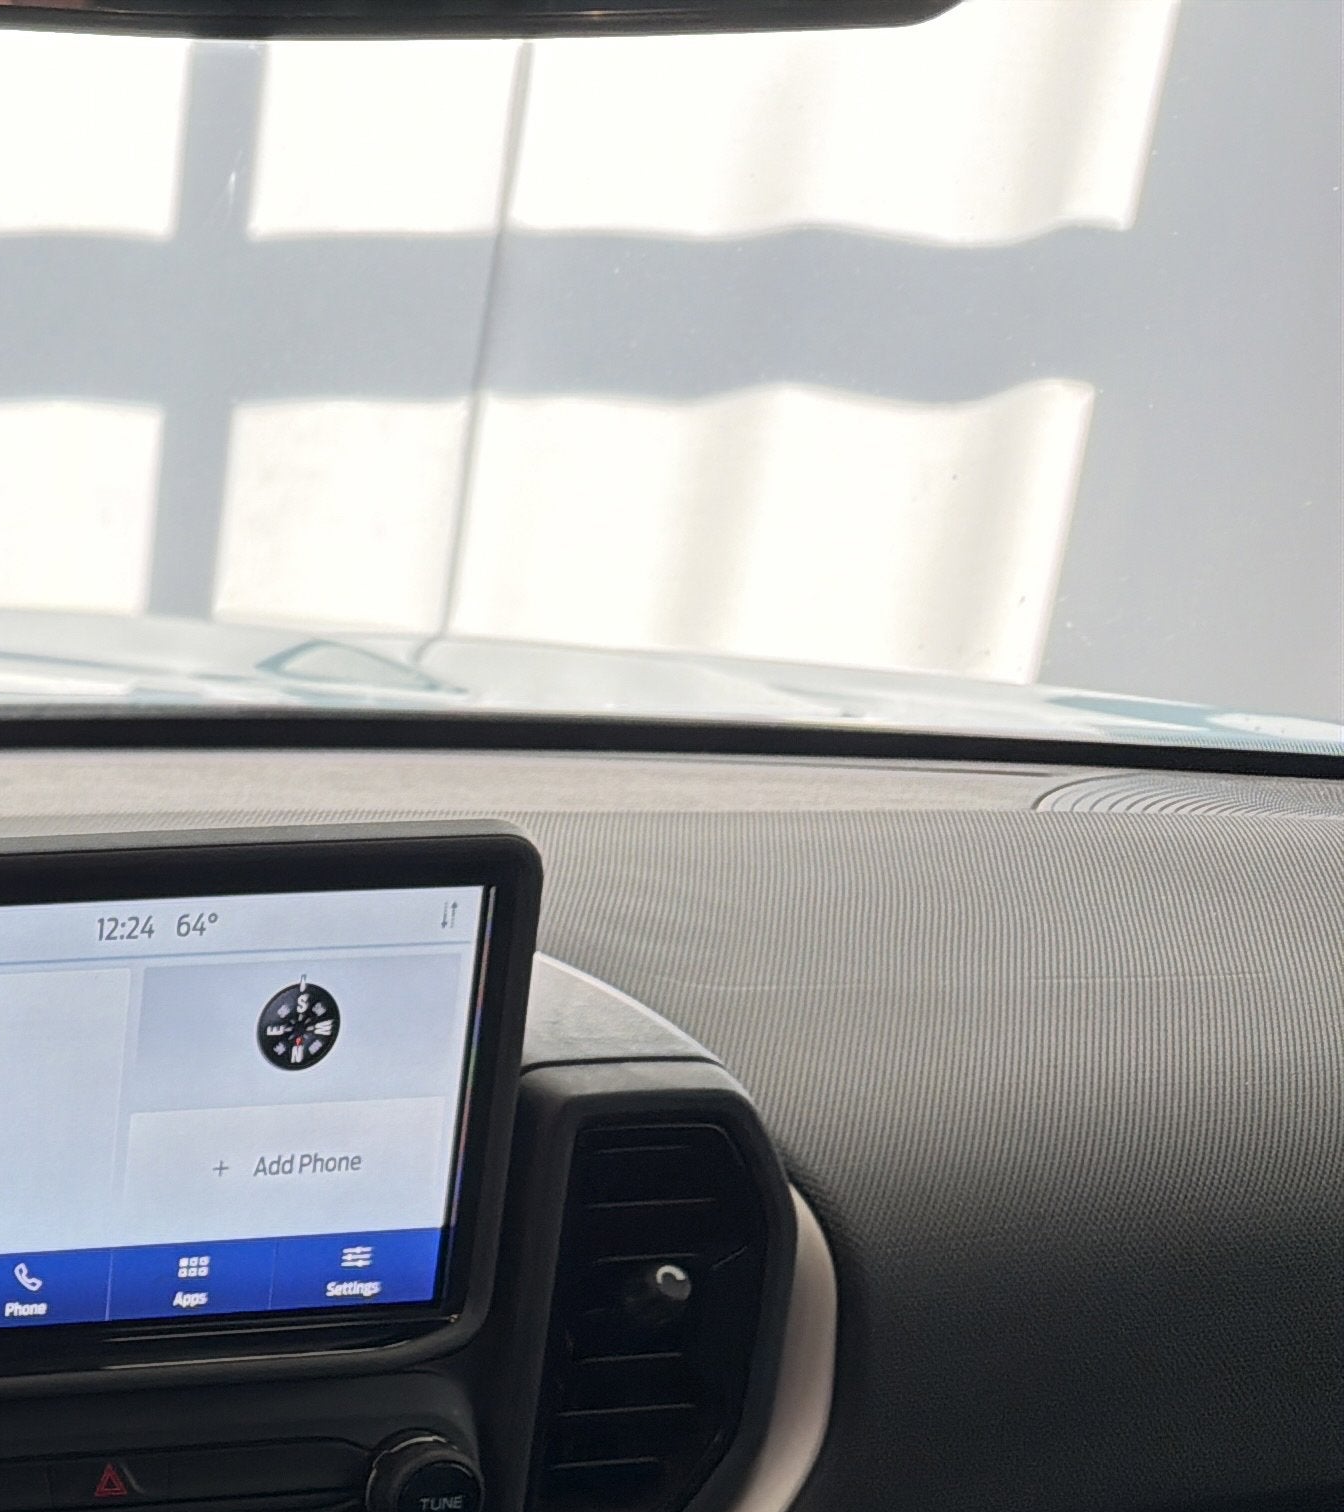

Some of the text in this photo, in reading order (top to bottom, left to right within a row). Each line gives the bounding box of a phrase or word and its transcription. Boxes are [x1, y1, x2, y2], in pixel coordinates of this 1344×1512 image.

[97, 911, 220, 943] 12:24 64°
[253, 1149, 363, 1178] Add Phone
[326, 1278, 380, 1299] Settings
[5, 1299, 48, 1319] Phone
[173, 1289, 208, 1309] Apps
[419, 1496, 462, 1511] TUNE
